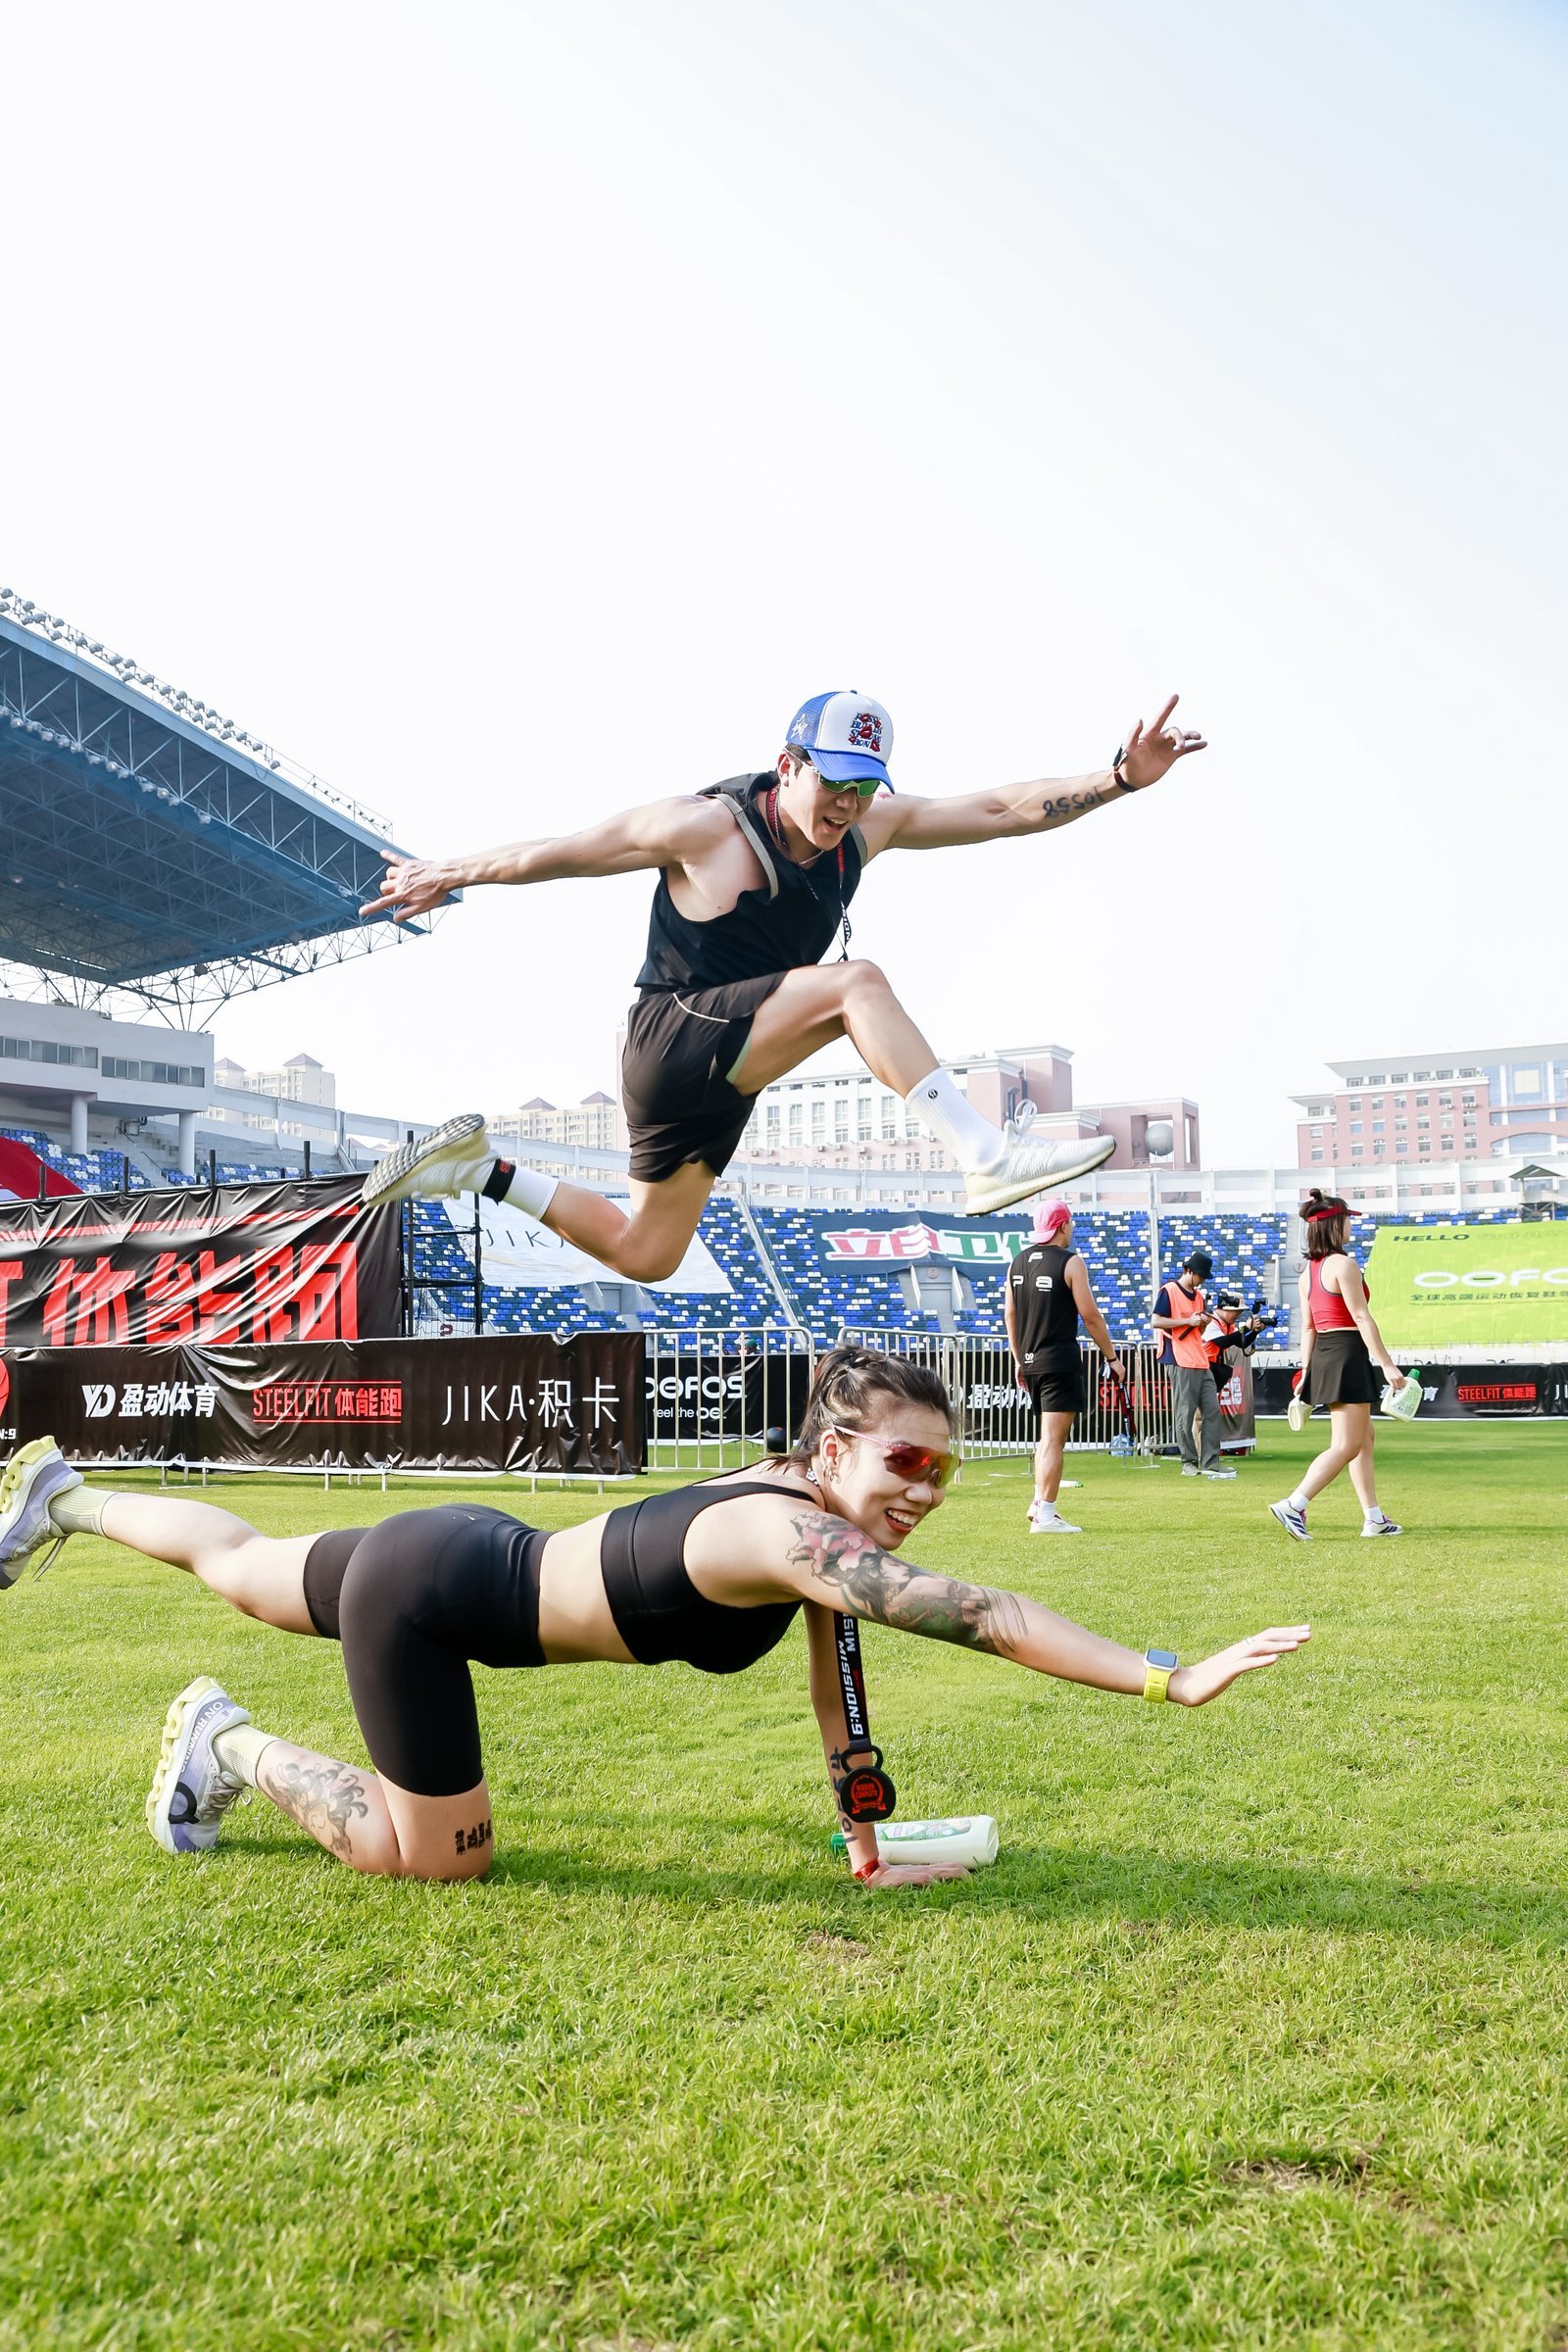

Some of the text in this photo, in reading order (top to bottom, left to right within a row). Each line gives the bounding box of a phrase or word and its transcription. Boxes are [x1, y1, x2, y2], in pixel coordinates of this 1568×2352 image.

[118, 1381, 220, 1418] 盈动体育
[335, 1388, 402, 1417] 体能跑
[1458, 1388, 1500, 1400] STEELFIT
[677, 1407, 695, 1418] he
[838, 1641, 864, 1736] MISSION:9
[204, 1701, 223, 1721] ON
